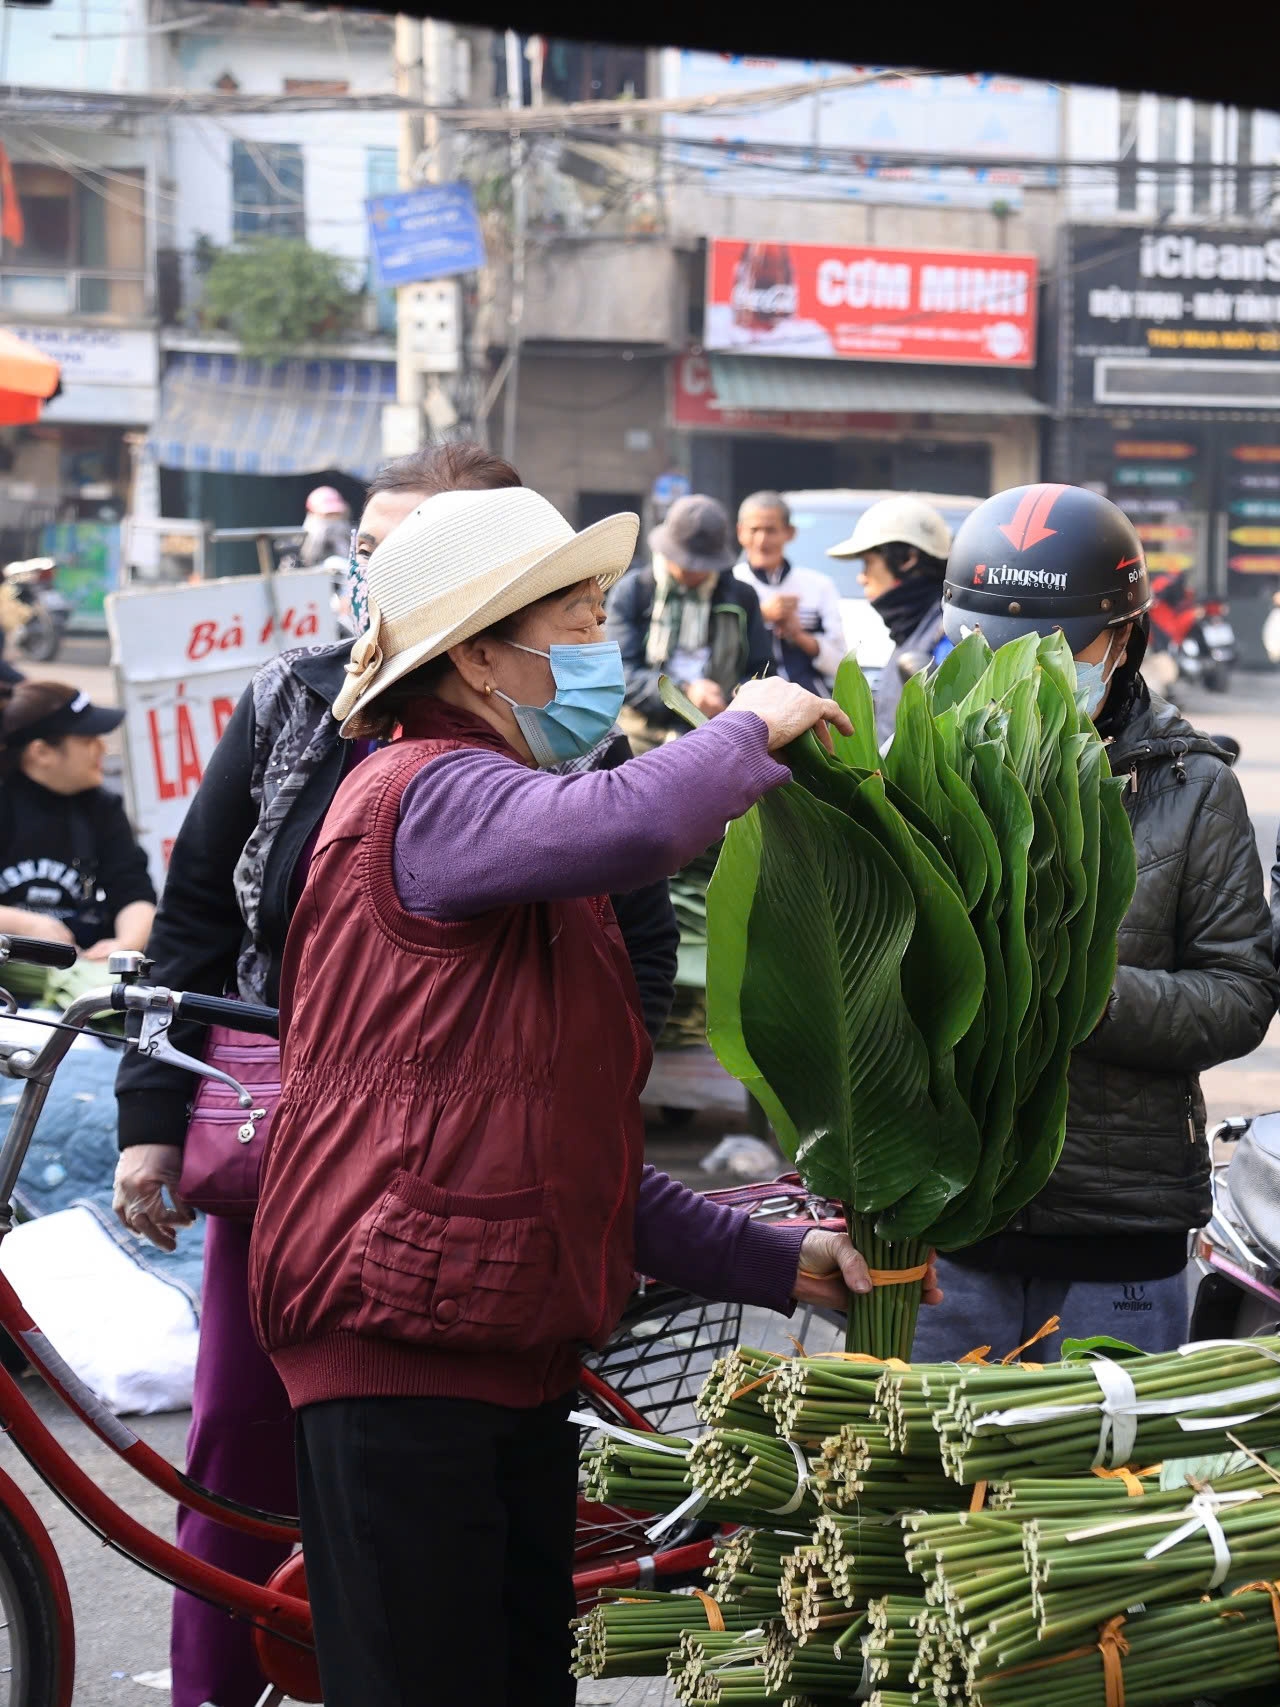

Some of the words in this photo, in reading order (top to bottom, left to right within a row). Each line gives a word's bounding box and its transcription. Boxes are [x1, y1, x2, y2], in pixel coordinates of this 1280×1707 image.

[817, 258, 911, 310] CƠM
[919, 265, 1028, 316] MINH
[987, 564, 1068, 587] Kingston
[1000, 580, 1066, 591] TECHNOLOGY
[148, 681, 204, 800] LÁ
